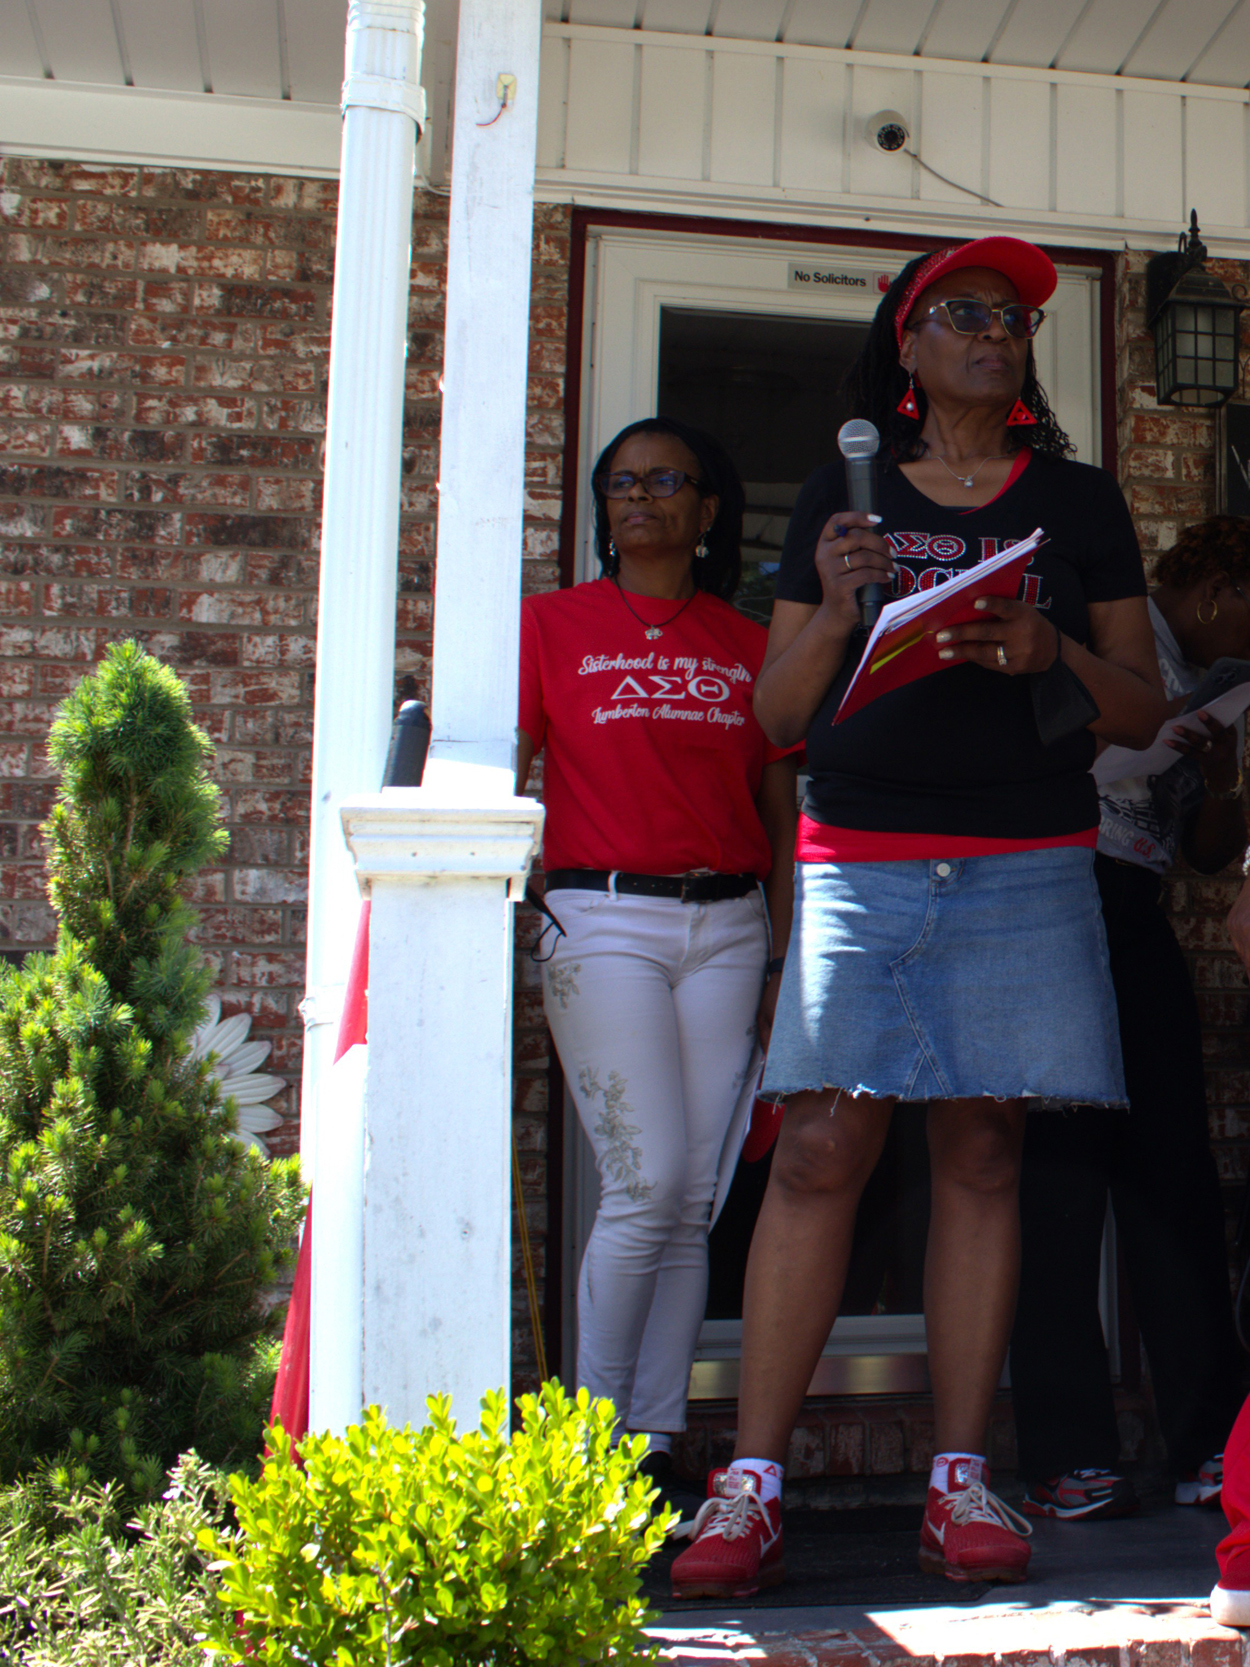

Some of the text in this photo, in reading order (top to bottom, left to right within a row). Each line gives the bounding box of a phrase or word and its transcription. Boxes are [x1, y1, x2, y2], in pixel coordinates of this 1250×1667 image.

[794, 270, 867, 287] No Solicitors
[578, 652, 753, 684] Sisterhood is my strength
[610, 675, 731, 702] ΔΣΘ
[591, 703, 745, 730] Lumberton Alumnae Chapter
